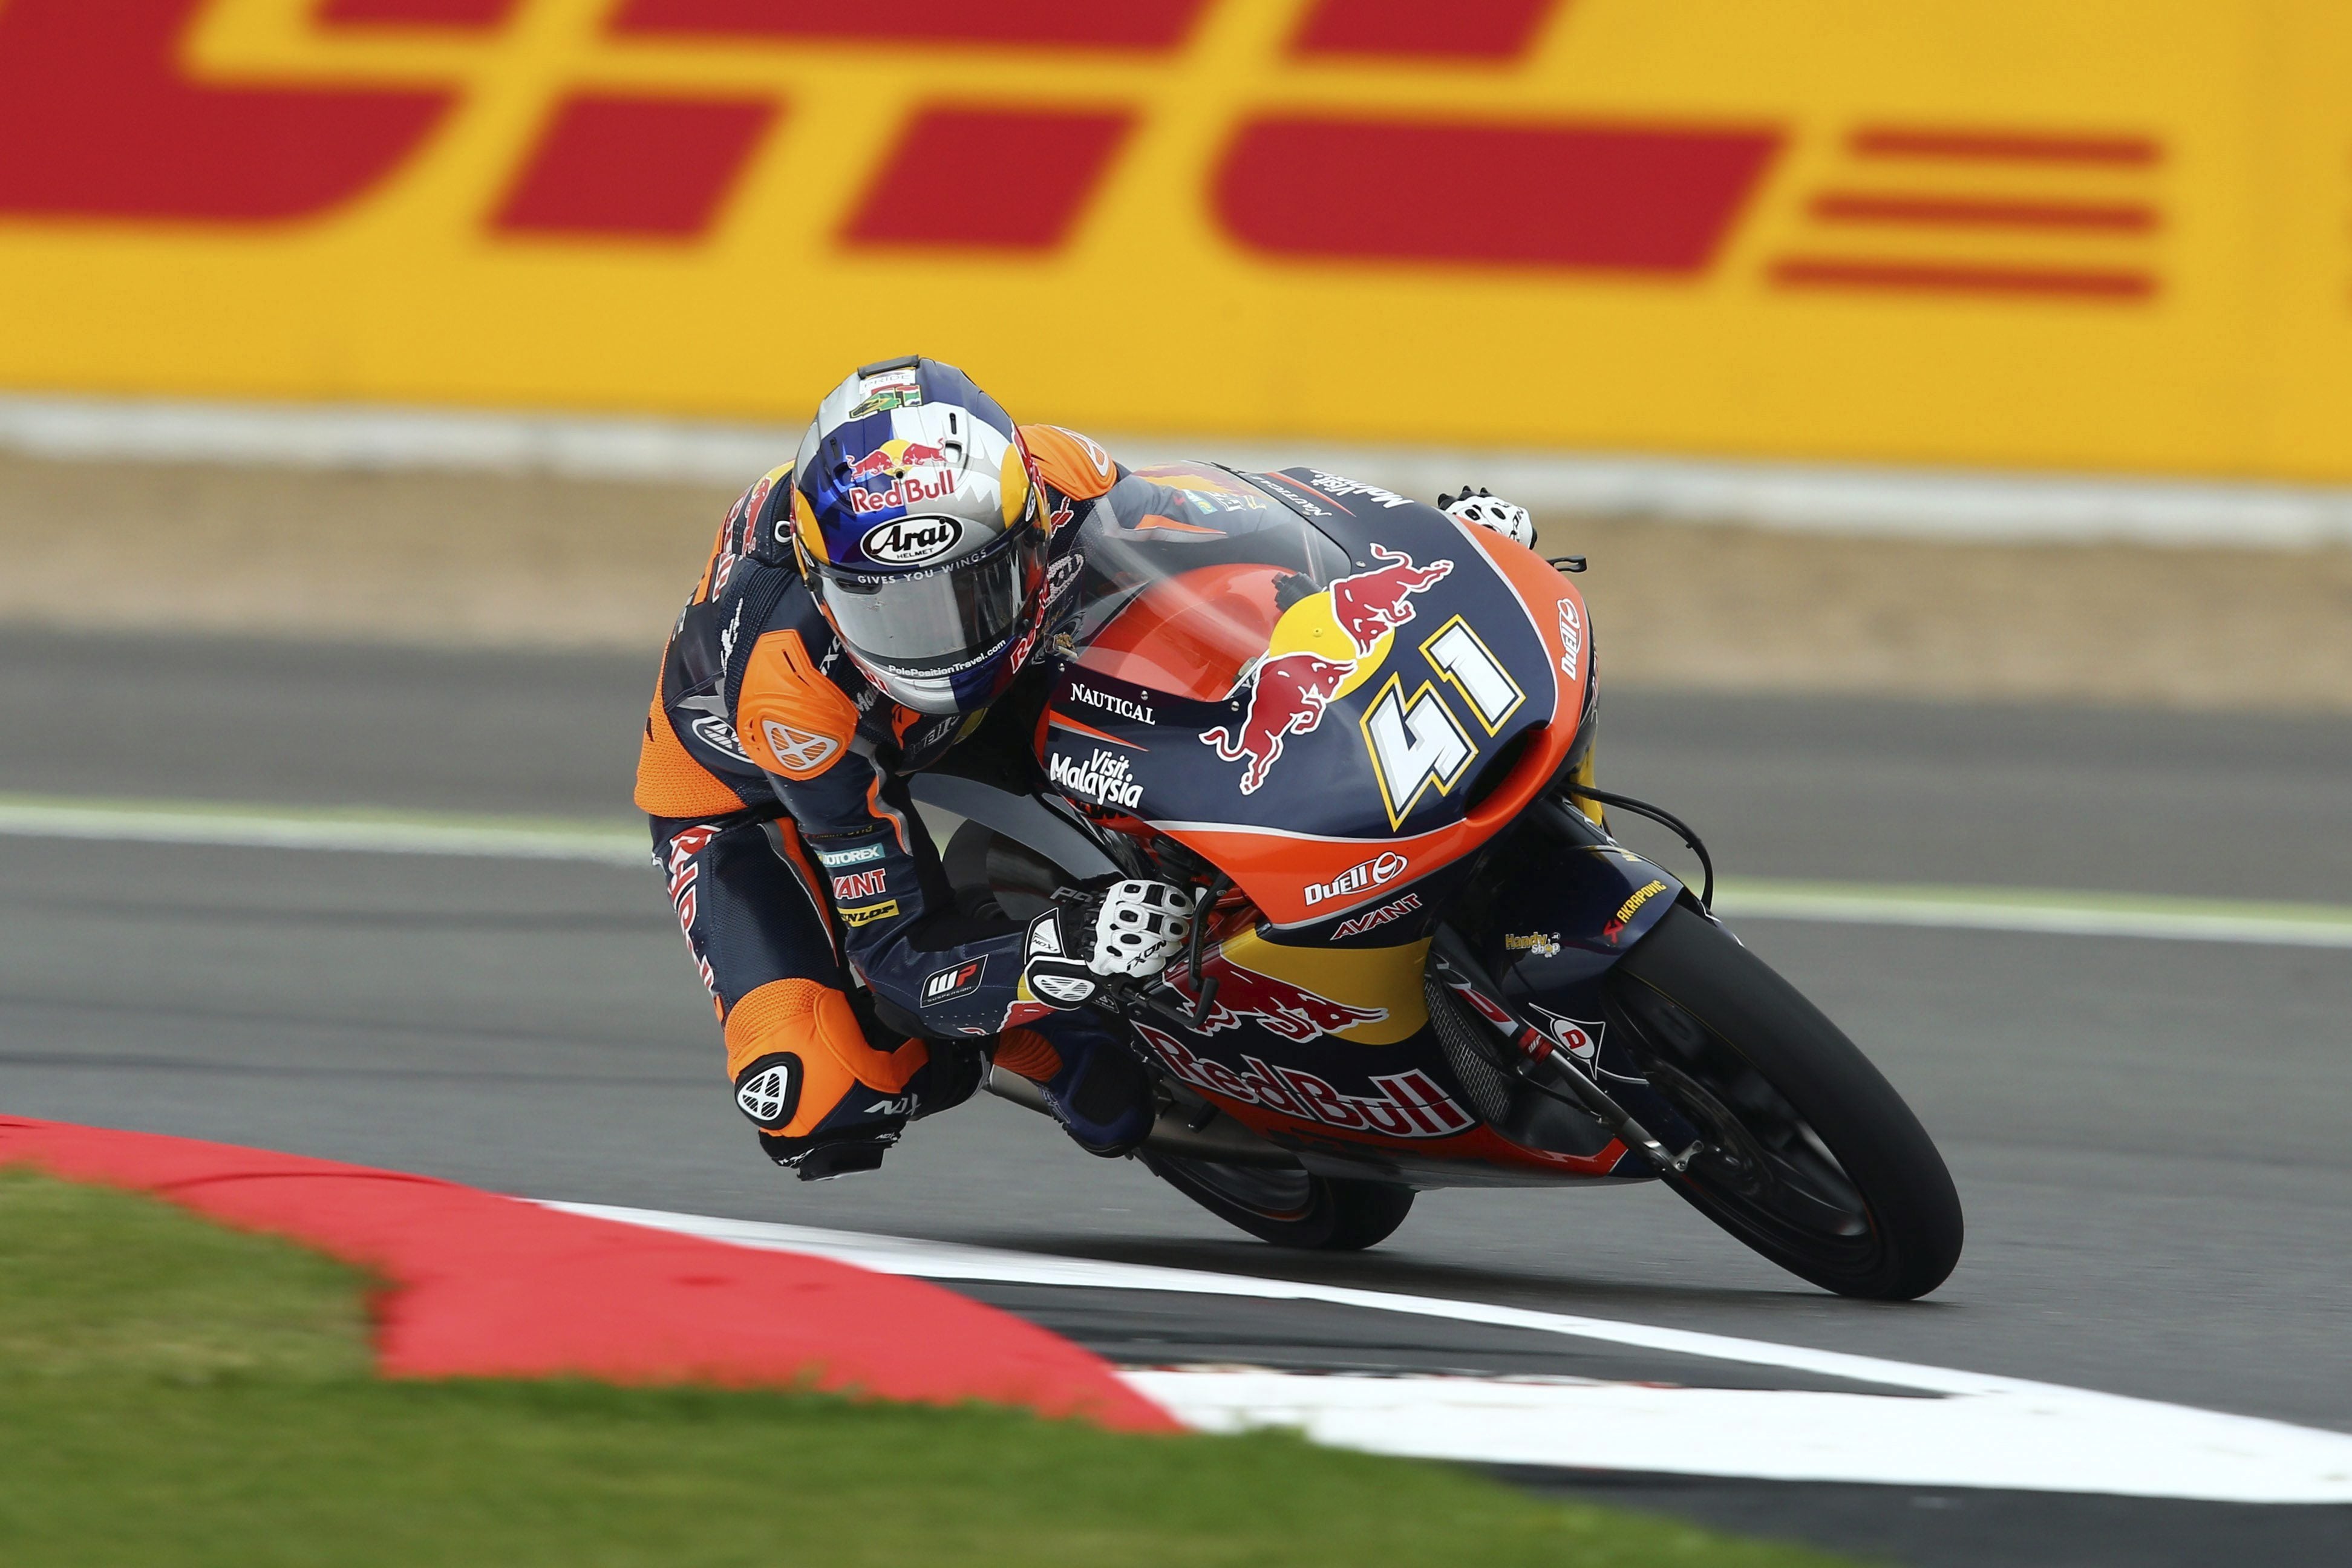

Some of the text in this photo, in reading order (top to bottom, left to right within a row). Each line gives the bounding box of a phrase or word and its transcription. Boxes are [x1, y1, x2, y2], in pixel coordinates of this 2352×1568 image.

[849, 469, 955, 514] Red Bull
[871, 517, 950, 555] Arai
[897, 547, 934, 560] HELMET
[857, 549, 987, 584] GIVES YOU WINGS
[888, 639, 1007, 677] PolePositionTravel.com
[1070, 683, 1156, 725] NAUTICAL
[1359, 613, 1526, 832] 41
[1050, 753, 1145, 809] Malaysia
[1090, 748, 1130, 780] Visit
[1330, 892, 1423, 941] AVANT
[1126, 939, 1166, 972] IXON
[1505, 932, 1547, 950] Handy
[927, 963, 978, 998] WP
[1562, 1029, 1586, 1050] D
[1129, 1019, 1318, 1120] Red
[1272, 1064, 1475, 1137] Bull
